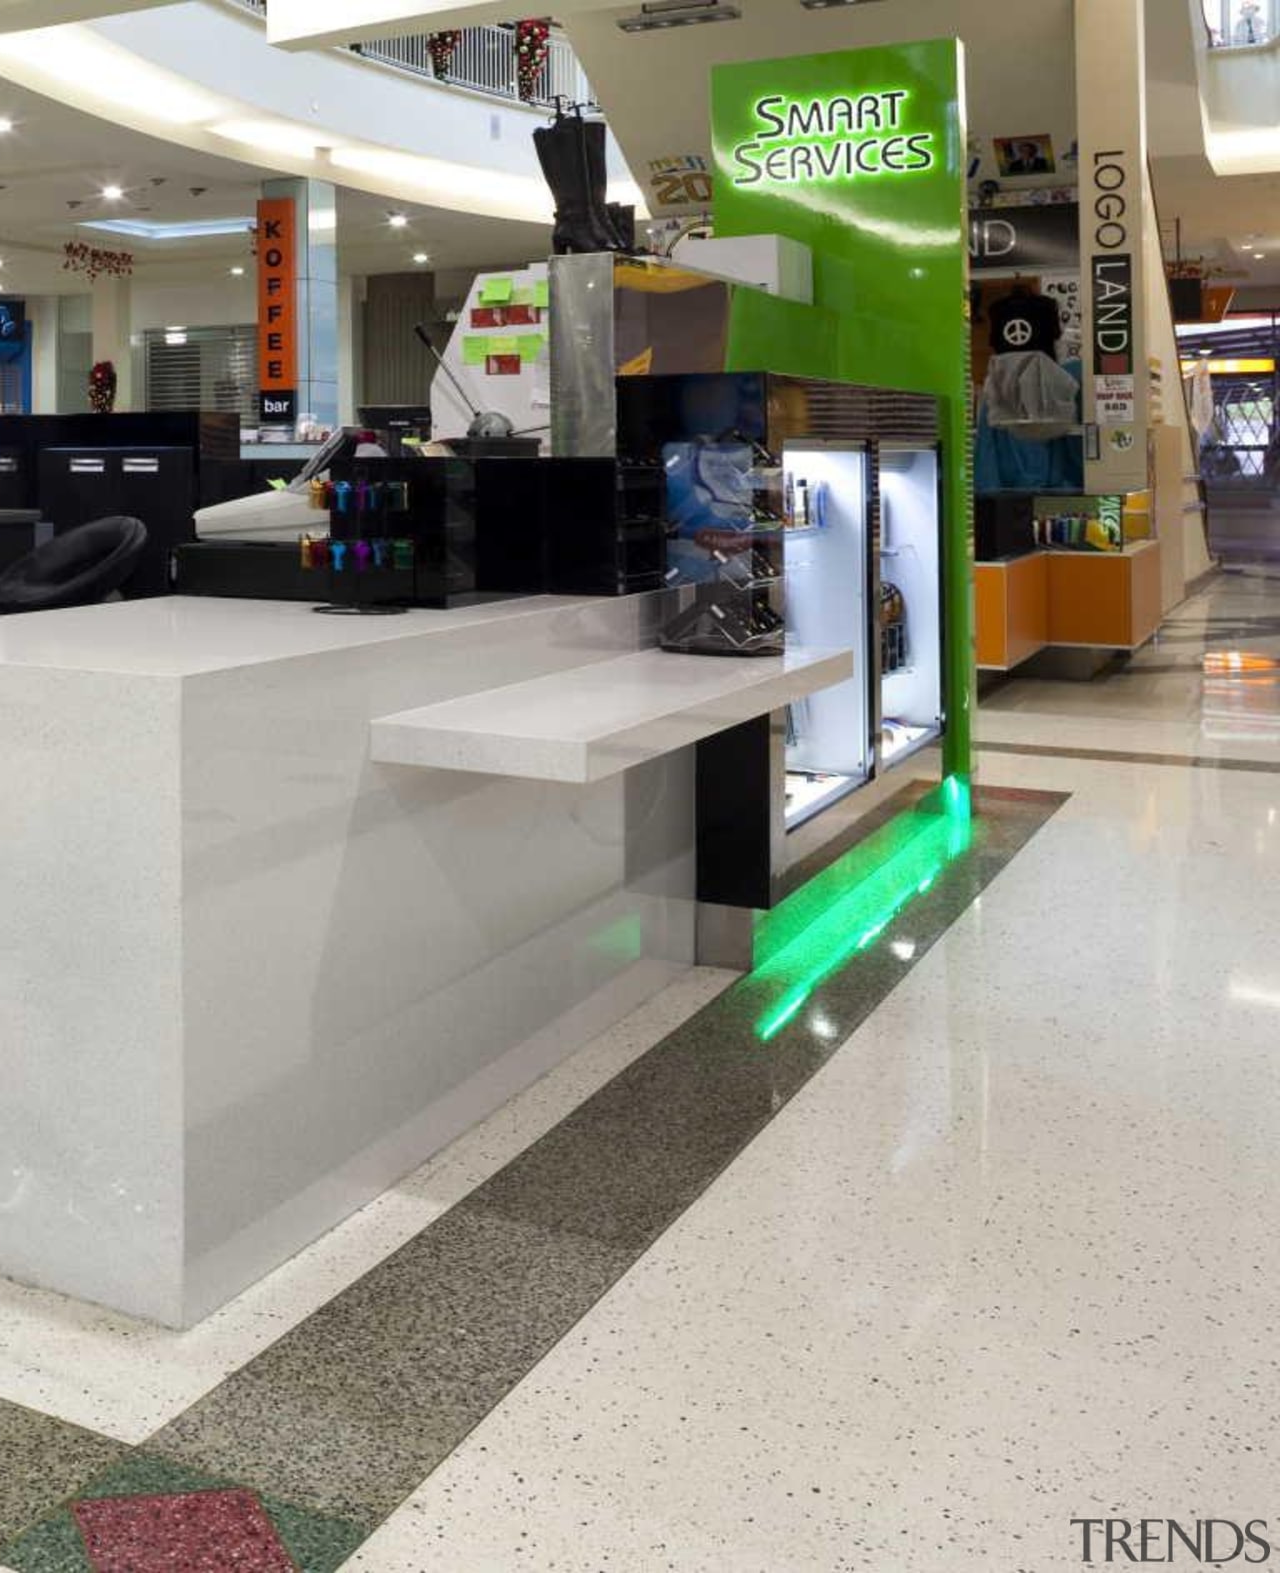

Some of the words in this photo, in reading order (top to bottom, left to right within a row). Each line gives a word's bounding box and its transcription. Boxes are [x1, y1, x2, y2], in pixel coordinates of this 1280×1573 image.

[754, 90, 906, 140] SMART
[733, 134, 933, 185] SERVICES
[1093, 150, 1126, 249] LOGO
[264, 220, 283, 379] KOFFEE
[1095, 262, 1128, 354] LAND
[263, 399, 290, 413] bar
